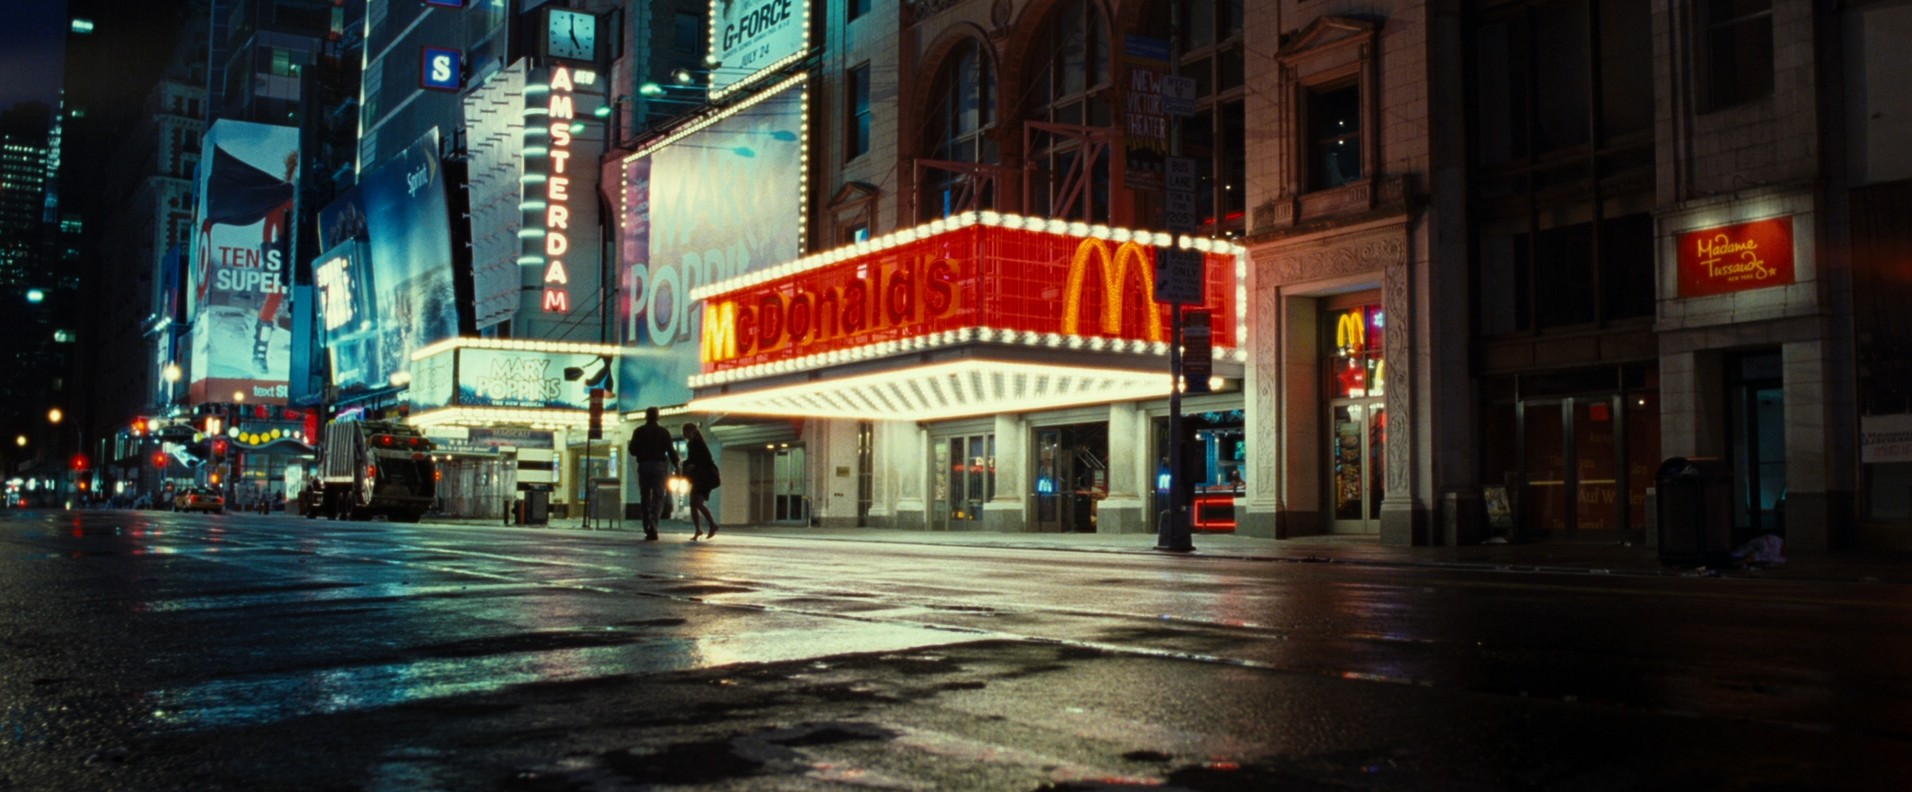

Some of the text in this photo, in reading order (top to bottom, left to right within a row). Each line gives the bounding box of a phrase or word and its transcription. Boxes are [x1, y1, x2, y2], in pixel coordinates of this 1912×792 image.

[723, 0, 791, 51] G-FORCE
[432, 55, 451, 82] S
[740, 43, 770, 69] JULY 24
[1131, 69, 1163, 93] NEW
[1126, 113, 1166, 138] THEATER
[1172, 160, 1189, 174] BUS
[407, 163, 428, 197] Sprint
[544, 67, 573, 311] AMSTERDAM
[1169, 176, 1192, 189] LANE
[1697, 234, 1758, 258] Madame
[1172, 265, 1198, 277] ONLY
[1700, 251, 1767, 279] Tussauds
[702, 254, 961, 363] McDonald's
[492, 356, 551, 381] MARY
[253, 385, 275, 397] text
[476, 375, 561, 400] POPPINS
